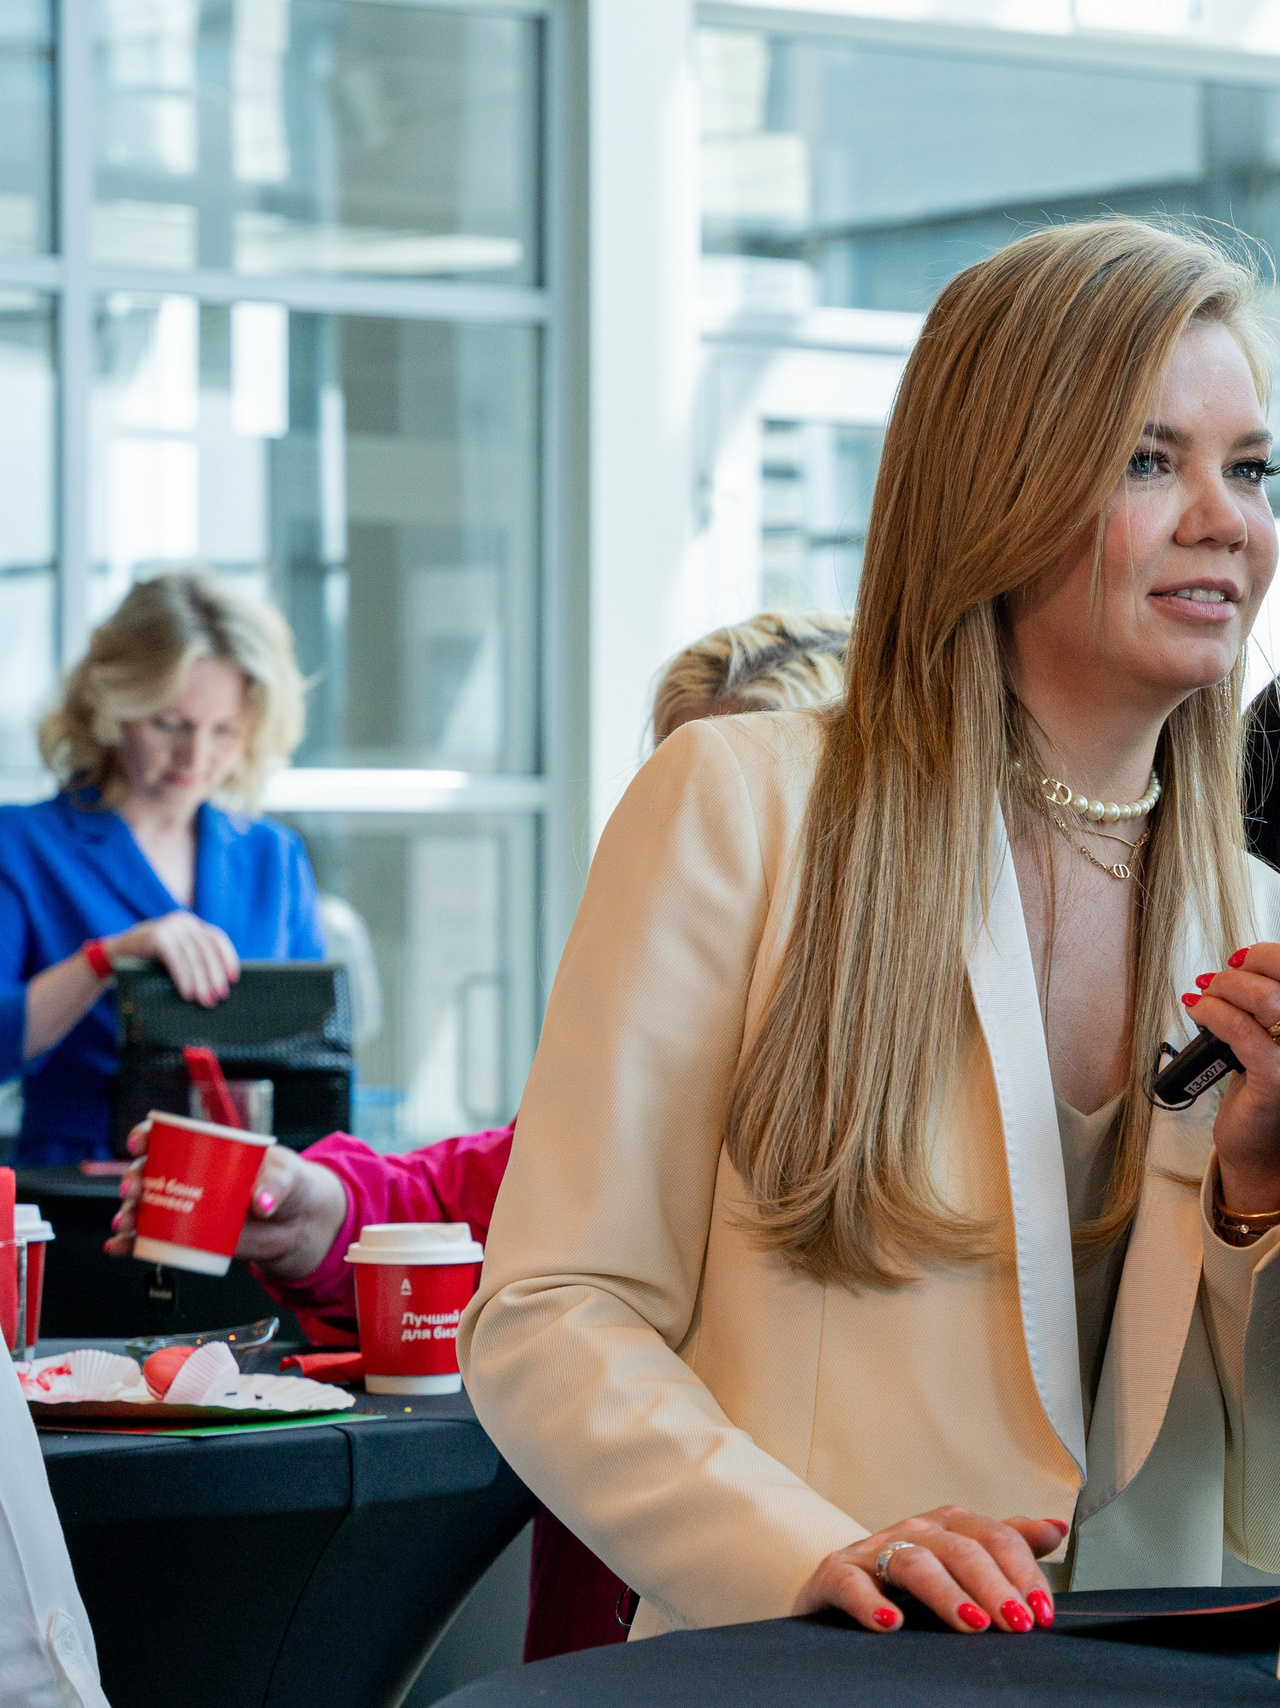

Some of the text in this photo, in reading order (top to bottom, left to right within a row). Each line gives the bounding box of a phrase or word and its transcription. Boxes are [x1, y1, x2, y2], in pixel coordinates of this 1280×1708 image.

[1188, 1065, 1219, 1093] 13-007
[401, 1309, 460, 1328] Лучший
[401, 1325, 458, 1342] для биз
